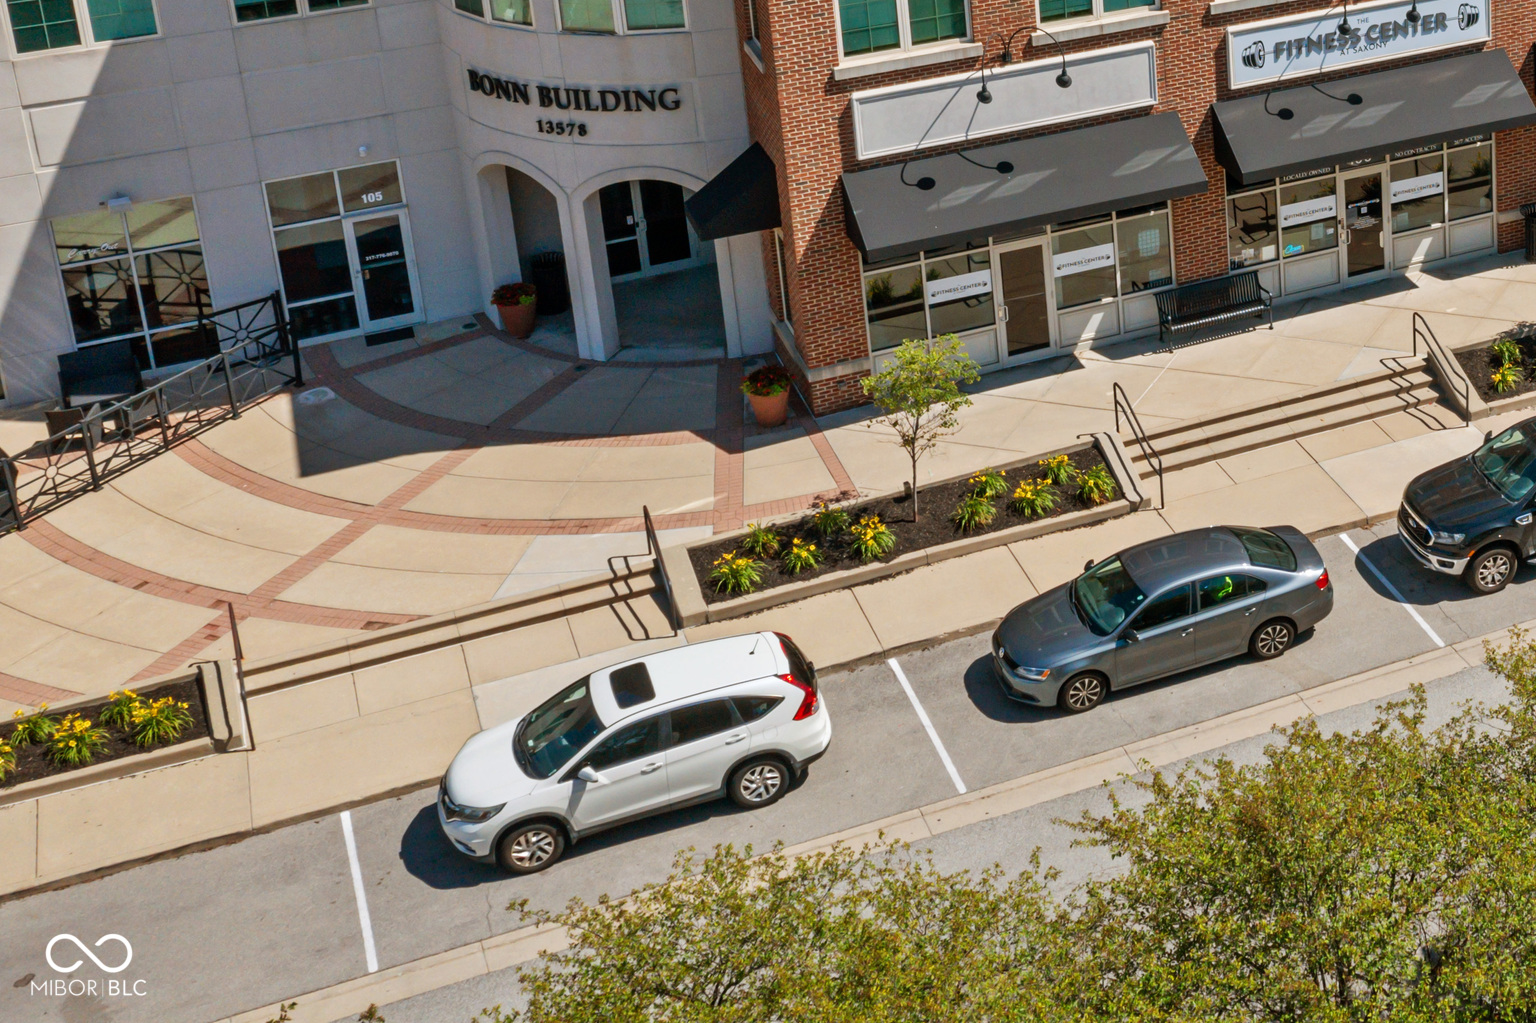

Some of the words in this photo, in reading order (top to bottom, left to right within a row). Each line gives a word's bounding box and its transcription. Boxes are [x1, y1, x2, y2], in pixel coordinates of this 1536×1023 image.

[1356, 16, 1370, 25] THE
[1274, 27, 1363, 61] FITNESS
[1364, 11, 1449, 43] CENTER
[1340, 47, 1352, 57] AT
[1353, 41, 1389, 54] SAXONY
[466, 68, 530, 105] BONN
[536, 85, 682, 112] BUILDING
[535, 118, 588, 137] 13578
[1404, 145, 1437, 156] CONTRACTS
[1283, 171, 1308, 182] LOCALLY
[1308, 167, 1331, 177] OWNED
[1397, 187, 1417, 195] FITNESS
[1417, 183, 1435, 192] CENTER
[361, 191, 383, 204] 105
[1288, 210, 1309, 219] FITNESS
[1309, 206, 1328, 215] CENTER
[1061, 259, 1084, 269] FITNESS
[1084, 255, 1105, 264] CENTER
[936, 286, 959, 296] FITNESS
[959, 282, 981, 291] CENTER
